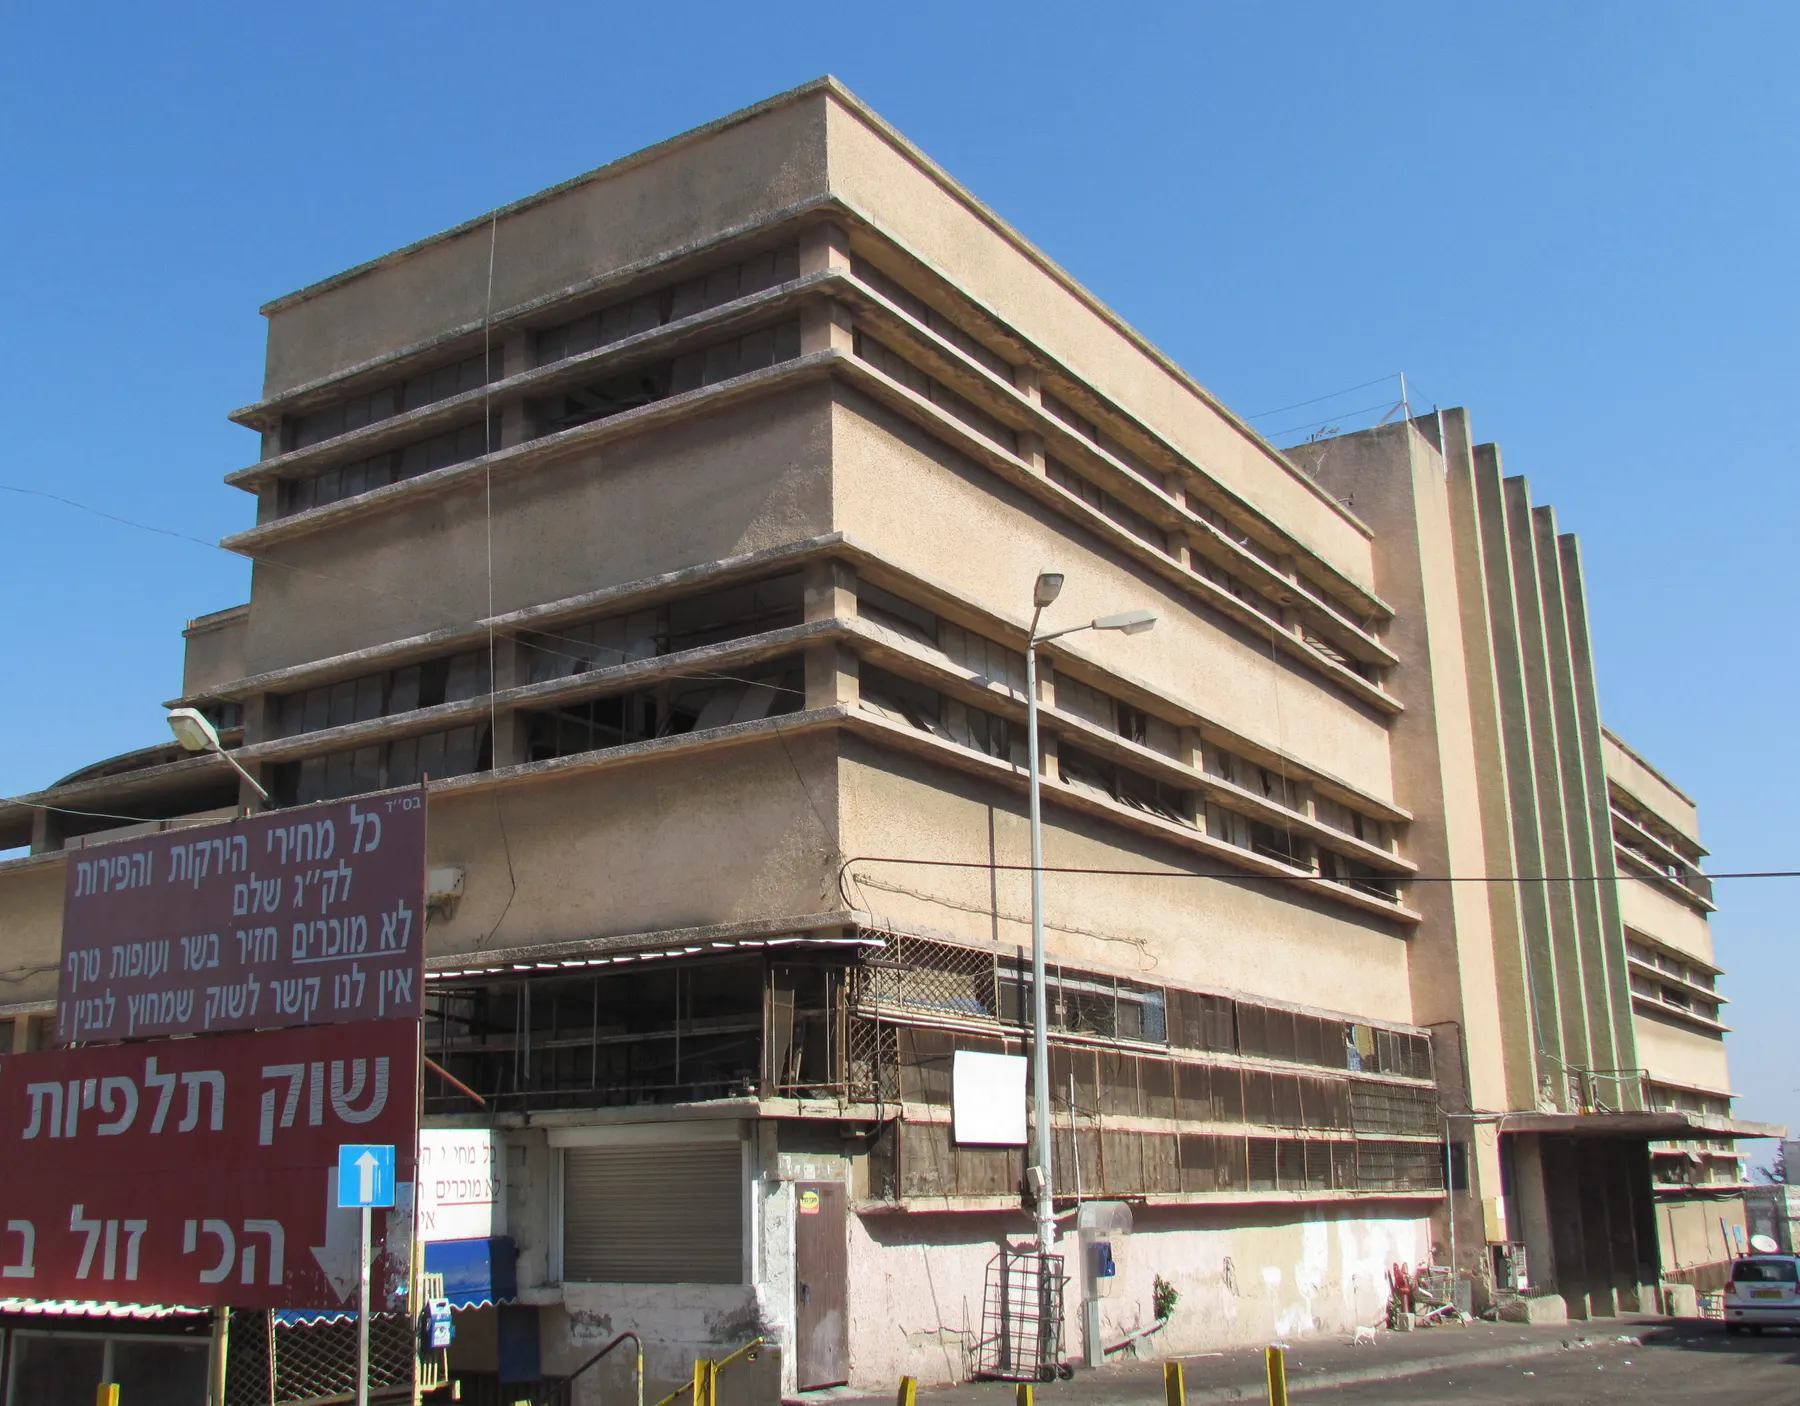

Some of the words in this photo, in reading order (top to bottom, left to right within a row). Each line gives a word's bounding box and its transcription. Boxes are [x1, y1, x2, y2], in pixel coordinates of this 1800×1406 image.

[267, 819, 335, 865] מחירי
[350, 804, 381, 854] כל
[75, 851, 153, 897] והפירות
[168, 835, 247, 890] הירקות
[233, 872, 281, 916] שלם
[236, 926, 278, 964] חזיר
[292, 915, 368, 959] מוכרים
[380, 899, 412, 949] לא
[67, 947, 100, 993] טרף
[109, 939, 170, 980] ועופות
[180, 933, 220, 971] בשר
[204, 973, 260, 1030] לשוק
[270, 976, 321, 1022] קשר
[334, 962, 366, 1009] לנו
[378, 967, 413, 1017] אין
[128, 989, 194, 1036] שמחוץ
[22, 1056, 225, 1139] תלפיות
[259, 1056, 390, 1146] שוק
[483, 1140, 497, 1165] כל
[436, 1179, 481, 1199] מוכרים
[486, 1174, 501, 1197] לא
[69, 1204, 147, 1281] זול
[420, 1210, 435, 1230] אי
[183, 1219, 284, 1285] הכי
